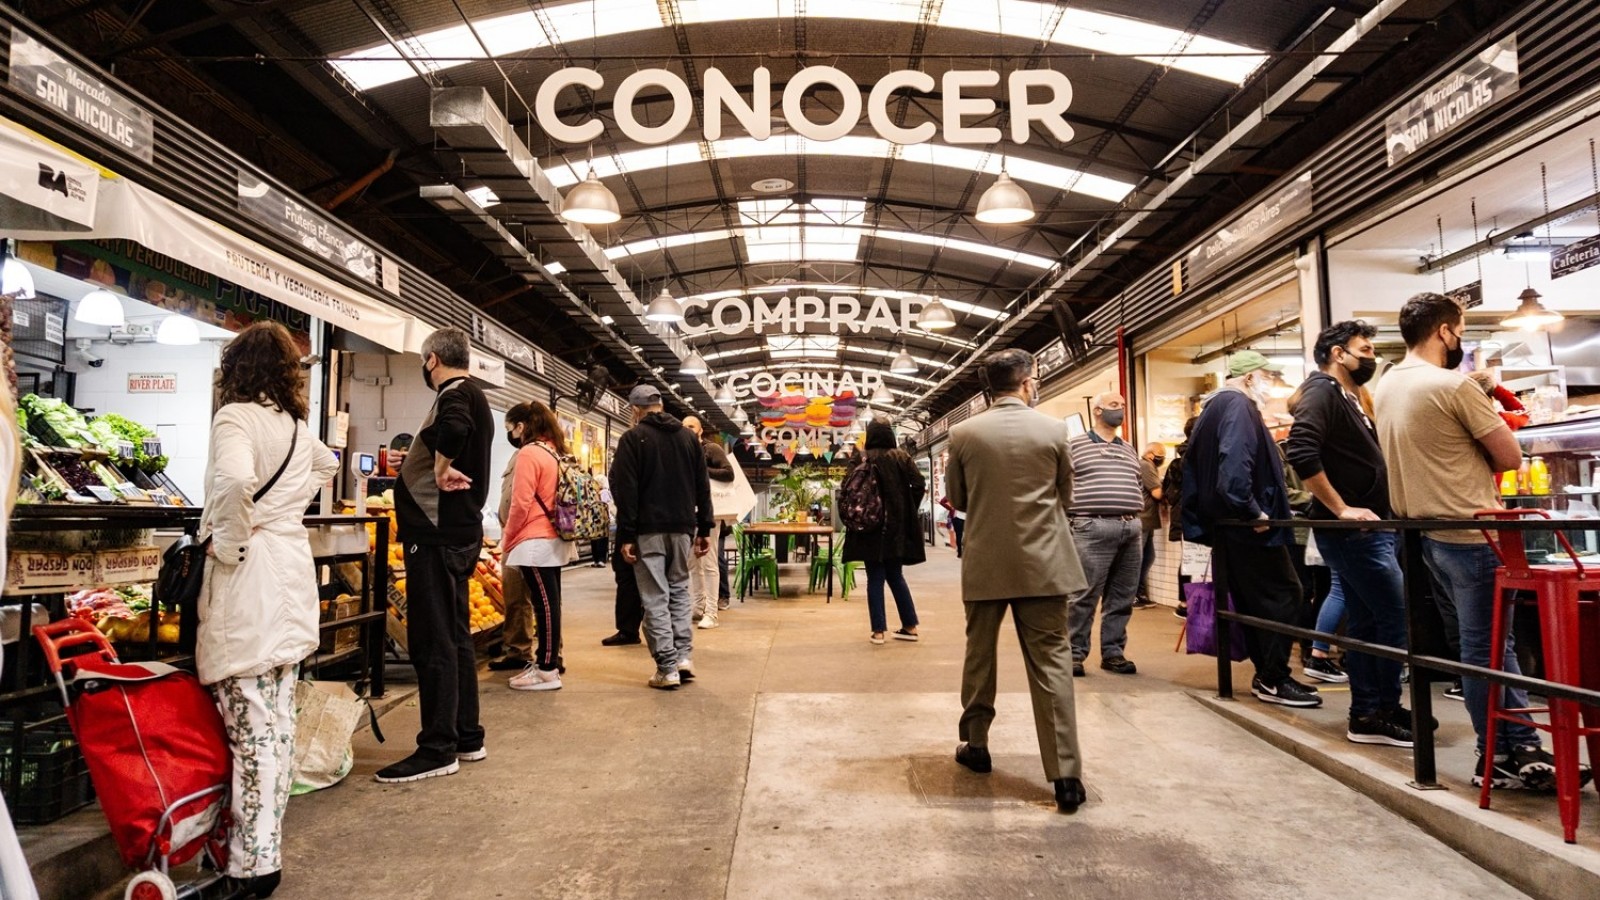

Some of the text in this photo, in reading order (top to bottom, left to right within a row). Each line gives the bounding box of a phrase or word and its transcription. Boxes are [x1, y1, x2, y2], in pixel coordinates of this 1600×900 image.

[66, 68, 111, 107] Mercado
[535, 65, 1075, 144] CONOCER
[1424, 75, 1465, 110] Mercado
[36, 73, 134, 148] SAN NICOLÁS
[1404, 76, 1493, 145] SAN NICOLÁS
[1260, 203, 1280, 225] Aires
[226, 250, 272, 281] FRUTERÍA
[274, 270, 281, 285] Y
[332, 298, 360, 320] FRANCO
[129, 379, 175, 390] RIVER PLATE
[727, 371, 882, 398] COCINAR
[27, 557, 69, 571] GASPAR
[106, 556, 140, 570] GASPAR
